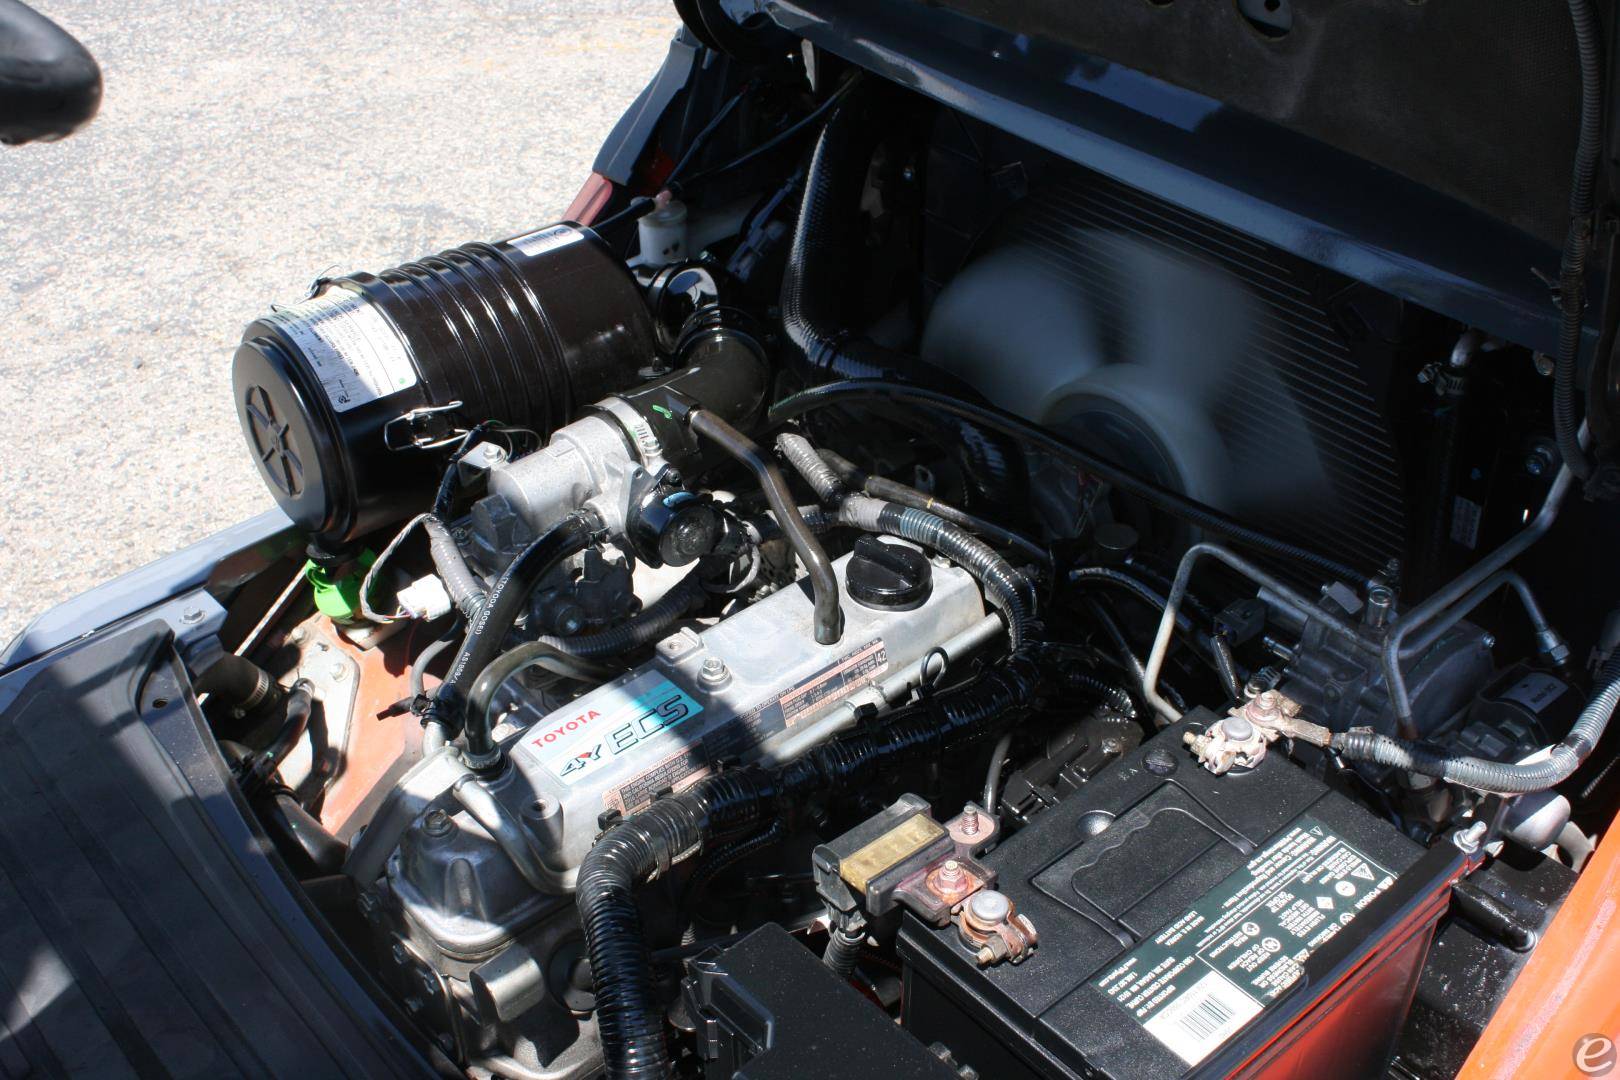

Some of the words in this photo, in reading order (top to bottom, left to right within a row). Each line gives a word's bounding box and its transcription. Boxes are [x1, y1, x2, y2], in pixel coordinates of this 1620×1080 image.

[874, 650, 888, 663] 42
[531, 709, 601, 748] TOYOTA
[559, 743, 602, 777] 4Y
[604, 694, 689, 755] ECS
[1354, 887, 1380, 909] POISON
[1183, 910, 1197, 921] LEAD
[1173, 919, 1186, 929] ACID
[1154, 927, 1175, 943] BATTERY
[1233, 935, 1248, 947] READ
[1208, 930, 1242, 958] INSTRUCTIONS
[1227, 949, 1252, 970] CHILDREN
[1239, 953, 1257, 968] REACH
[1255, 951, 1270, 963] KEEP
[1158, 962, 1185, 984] CORPORATE
[1246, 962, 1257, 971] OUT
[1141, 981, 1161, 997] CENTER
